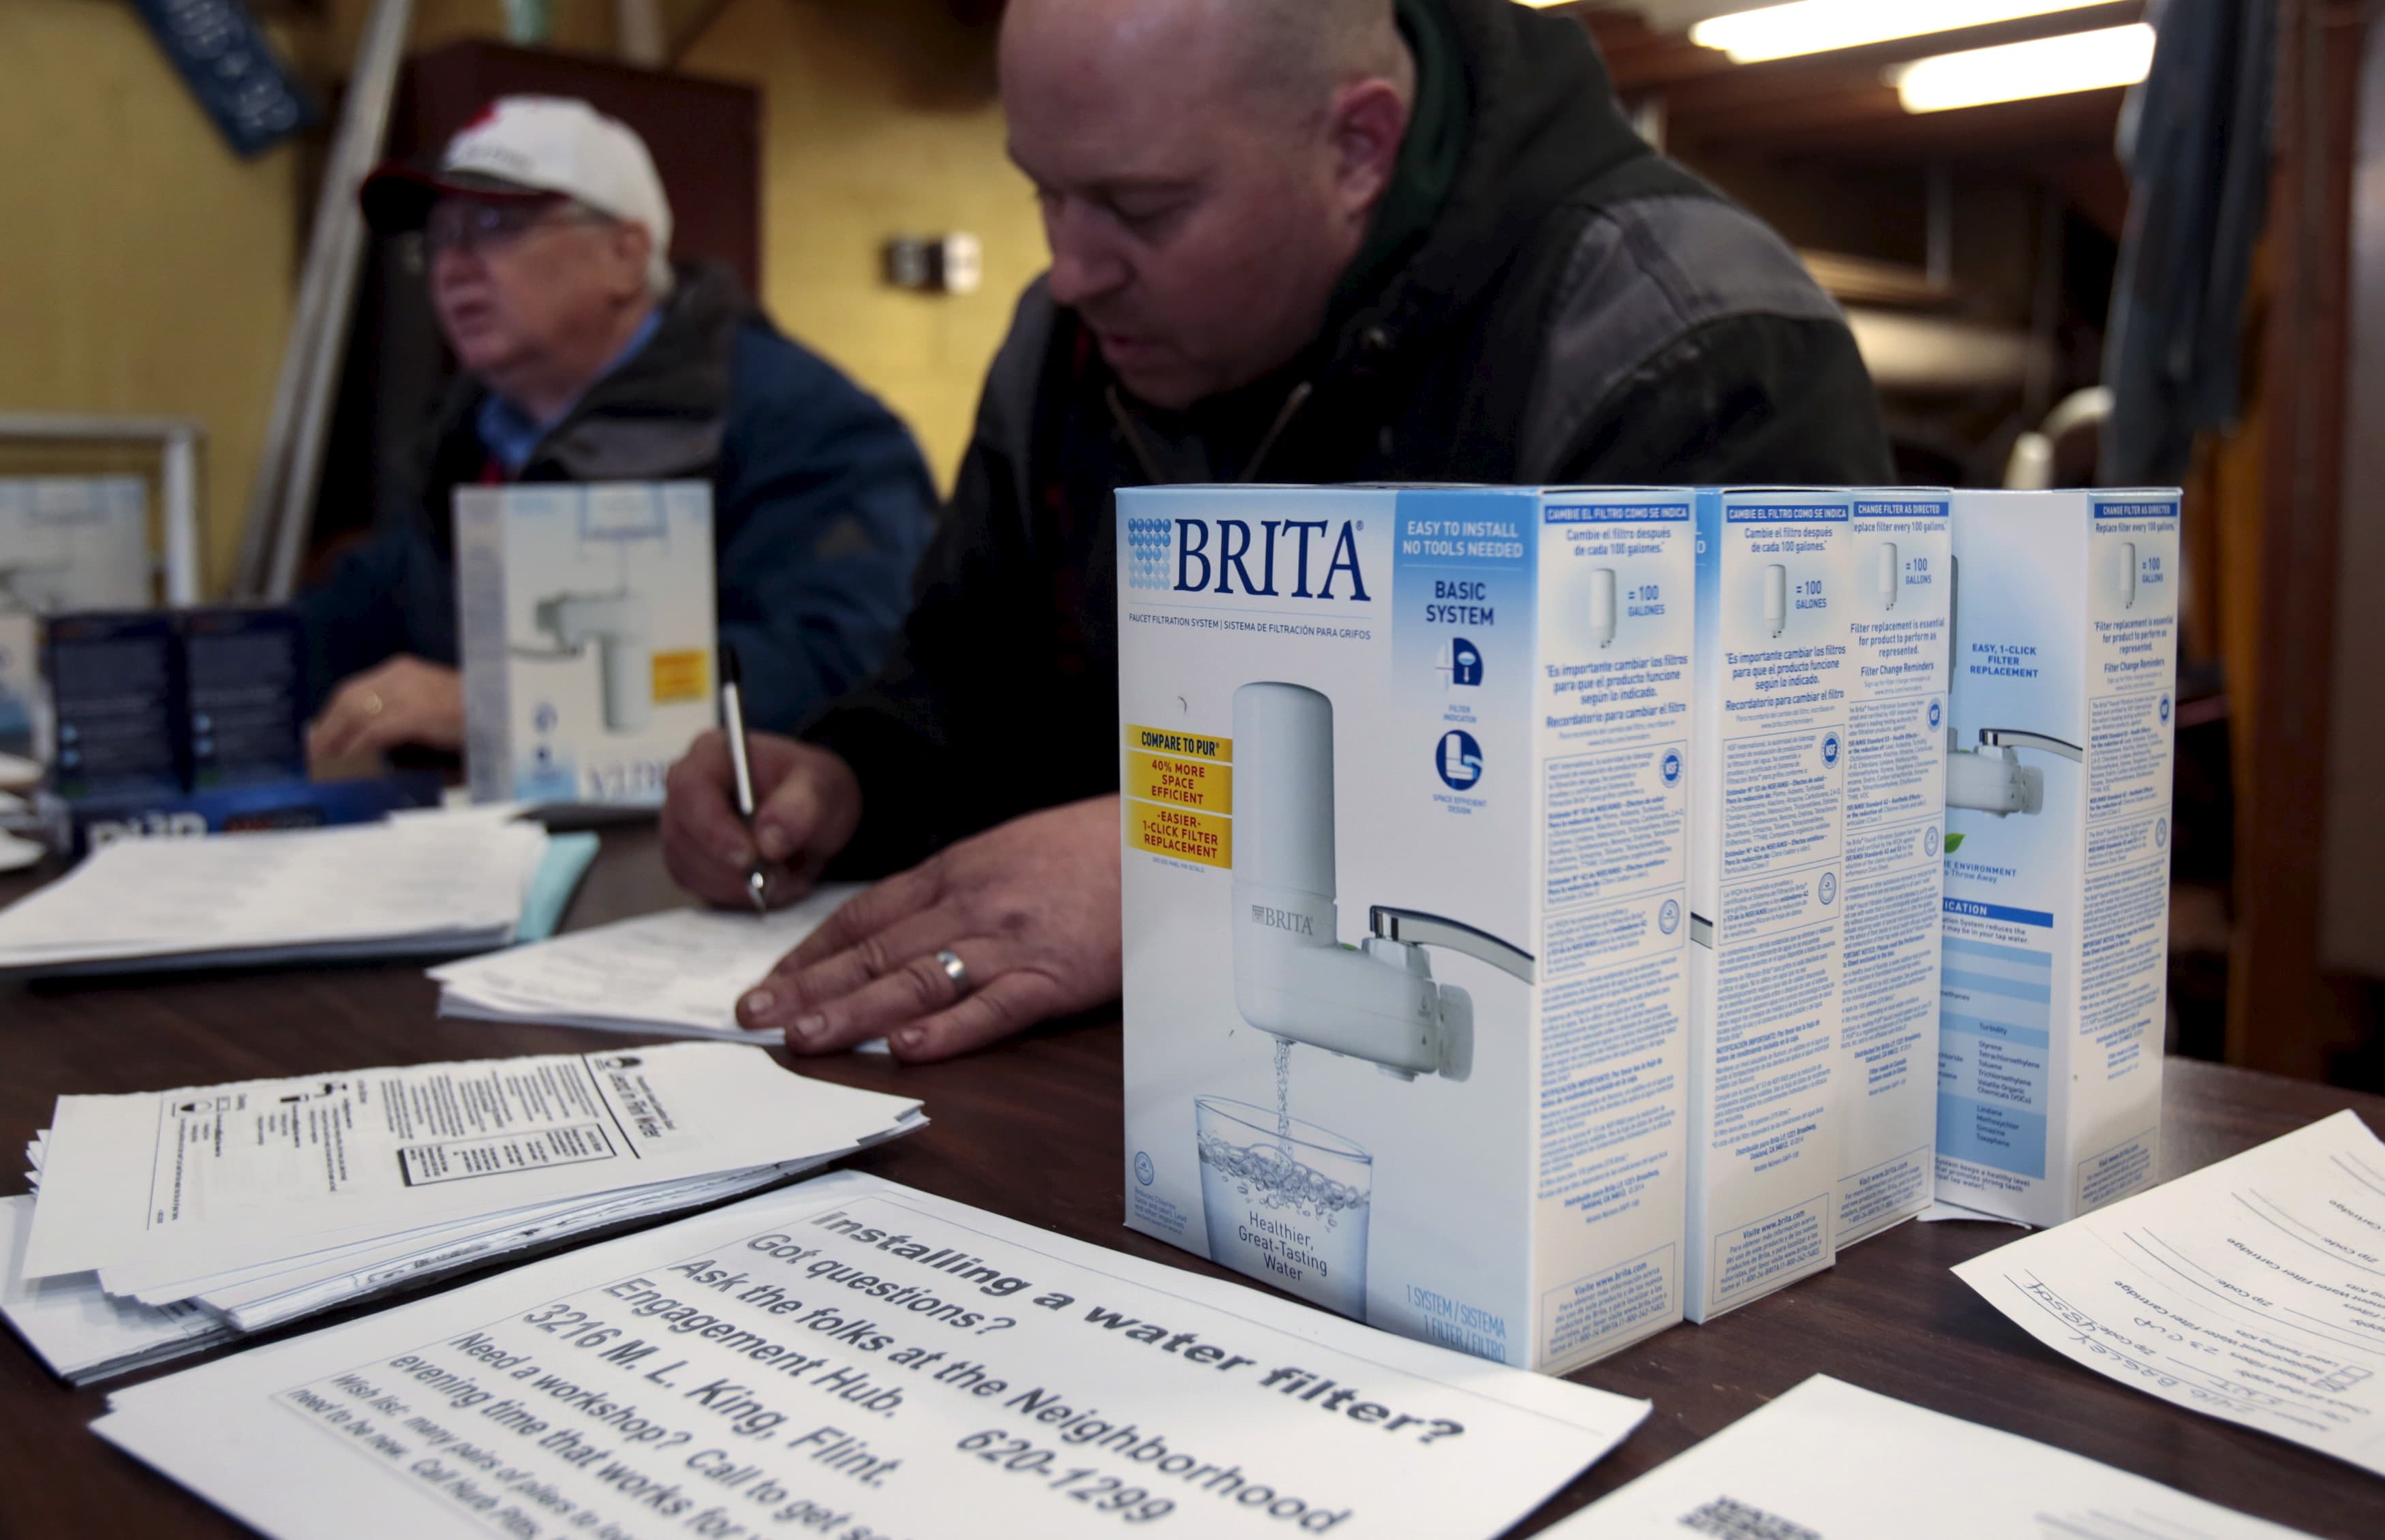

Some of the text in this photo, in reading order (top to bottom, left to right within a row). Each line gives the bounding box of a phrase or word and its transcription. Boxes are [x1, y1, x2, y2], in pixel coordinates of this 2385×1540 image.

[1729, 508, 1846, 519] CAMBIE EL FILTRO COMO SE INDICA
[1858, 505, 1940, 514] CHANGE FILTER AS DIRECTED
[1407, 521, 1519, 538] EASY TO INSTALL
[1854, 523, 1875, 534] eplace
[1877, 522, 1892, 532] filter
[1894, 523, 1910, 534] every
[1912, 522, 1922, 531] 100
[1402, 540, 1524, 558] NO TOOLS NEEDED
[1913, 558, 1927, 571] 100
[1805, 581, 1821, 595] 100
[1905, 575, 1931, 585] GALLONS
[1435, 581, 1486, 600] BASIC
[1796, 598, 1827, 609] GALONES
[1426, 604, 1494, 626] SYSTEM
[1129, 613, 1152, 624] FAUCET
[1152, 615, 1190, 627] FILTRATION
[1191, 618, 1218, 629] SYSTEM
[1224, 621, 1255, 632] SISTEMA
[1257, 622, 1268, 632] DE
[1317, 628, 1338, 637] PARA
[1340, 628, 1371, 640] GRIFOS
[1851, 617, 1945, 634] Filter replacement is essential
[1859, 636, 1868, 646] for
[1871, 634, 1896, 647] product
[1905, 632, 1928, 644] perform
[1879, 645, 1919, 658] represented.
[1972, 643, 2036, 656] EASY, 1-CLICK
[1861, 662, 1934, 677] Filter Change Reminders
[1988, 655, 2019, 665] FILTER
[1970, 665, 2038, 678] REPLACEMENT
[1449, 705, 1471, 713] FILTER
[1725, 690, 1844, 711] Recordatorio para cambiar el filtro
[1443, 714, 1477, 723] INDICATOR
[1141, 731, 1181, 752] COMPARE
[1183, 737, 1195, 754] TO
[1152, 759, 1205, 778] 40% MORE
[1162, 774, 1195, 790] SPACE
[1152, 785, 1203, 805] EFFICIENT
[1143, 820, 1218, 846] 1-CLICK FILTER
[1144, 833, 1217, 859] REPLACEMENT
[1952, 869, 1997, 884] Throw Away
[1954, 861, 2017, 877] ENVIRONMENT
[1945, 900, 1987, 916] ICATION
[1980, 1023, 2007, 1035] Turbidity
[1250, 1210, 1314, 1250] Healthier,
[1743, 1210, 1804, 1239] Visite www.brita.com
[1239, 1225, 1327, 1277] Great-Tasting
[1263, 1252, 1303, 1281] Water
[747, 1233, 1017, 1336] Got questions?
[2213, 1276, 2274, 1308] Zip Code:
[2114, 1279, 2169, 1315] Cartridge
[1406, 1284, 1506, 1339] 1 SYSTEM SISTEMA
[810, 1210, 1466, 1445] Installing a water filter?
[2169, 1312, 2202, 1331] Filter
[602, 1276, 905, 1418] Engagement Hub.
[1424, 1315, 1506, 1364] 1 FILTER FILTRO
[2096, 1323, 2157, 1357] Zip Code:
[2202, 1329, 2238, 1346] Water
[522, 1302, 905, 1488] 3216 M. L. King, Flint.
[668, 1259, 1353, 1535] Ask the folks at the Neighborhood
[287, 1389, 342, 1413] need
[324, 1404, 354, 1423] to
[329, 1372, 383, 1399] Wish
[402, 1415, 461, 1447] many
[448, 1331, 859, 1537] Need a workshop? Call to get
[388, 1355, 750, 1539] evening time that works for
[955, 1428, 1176, 1524] 620-1299
